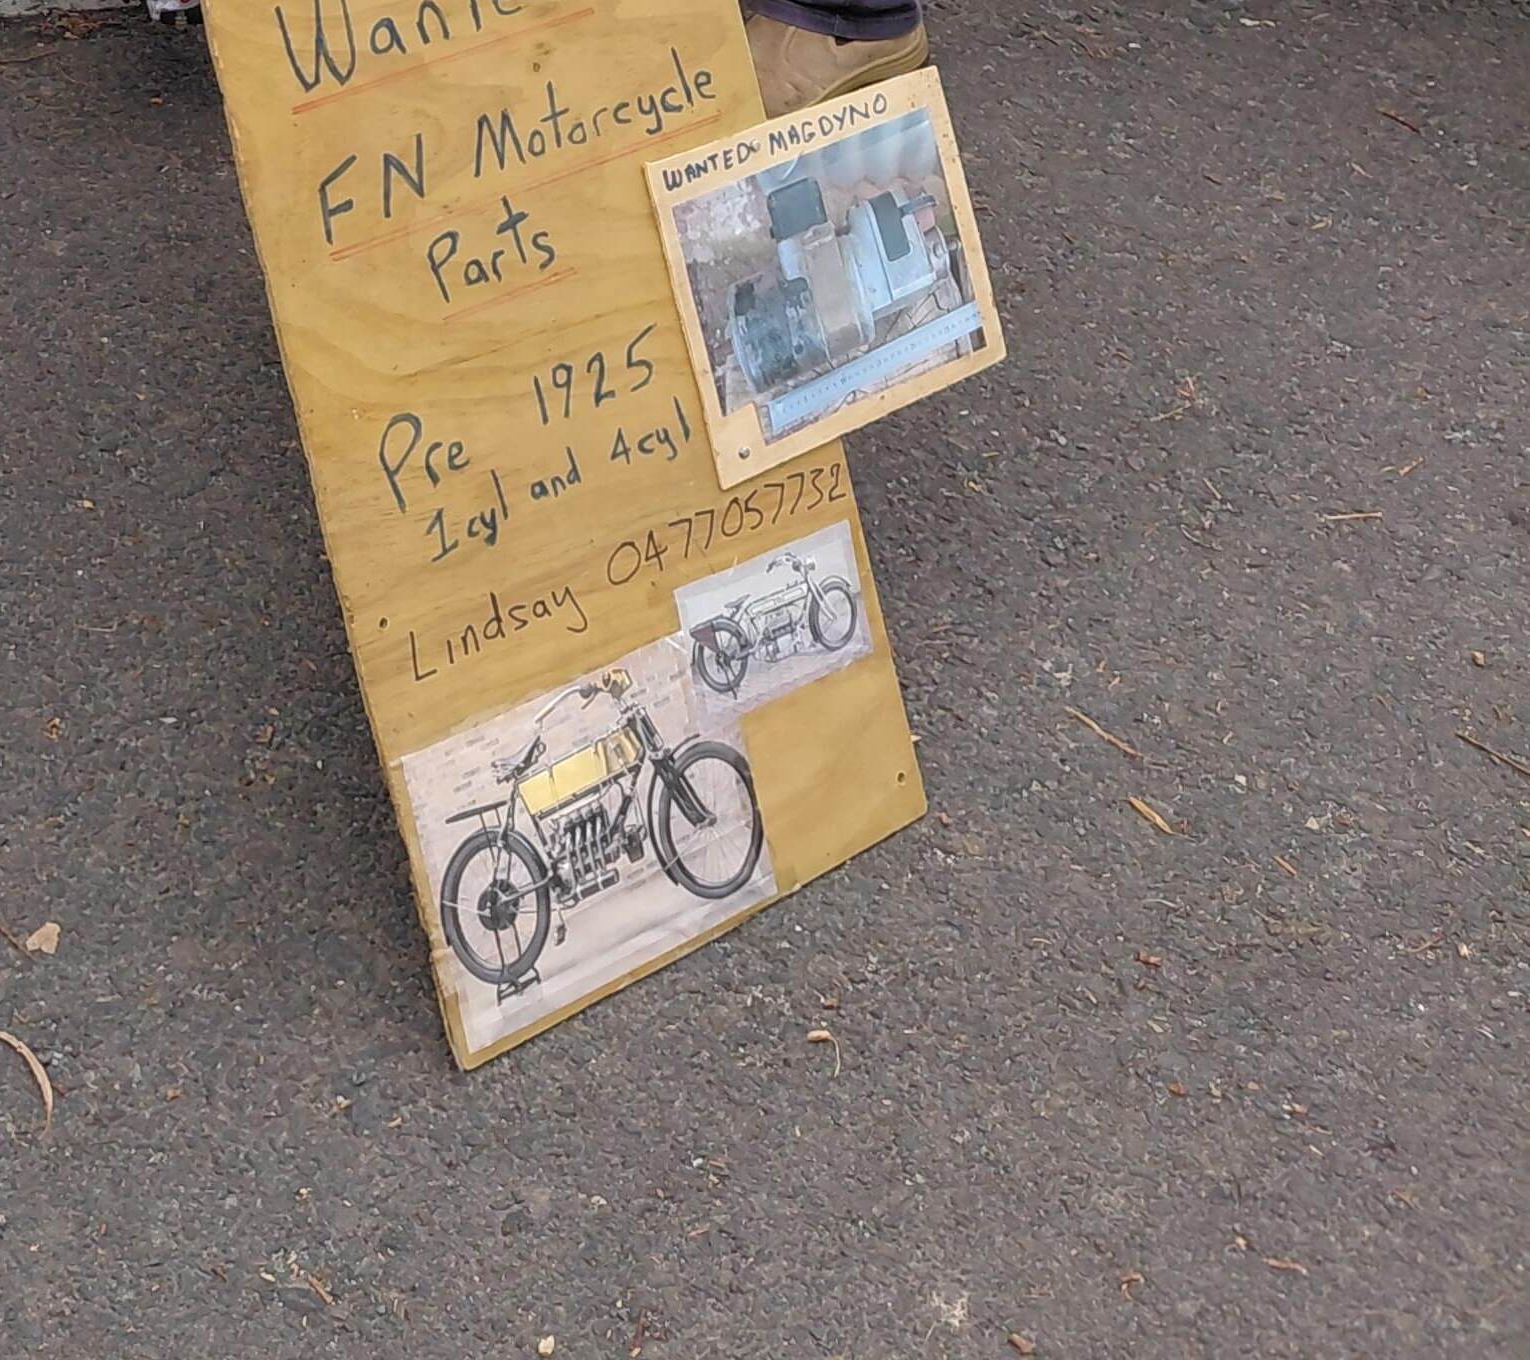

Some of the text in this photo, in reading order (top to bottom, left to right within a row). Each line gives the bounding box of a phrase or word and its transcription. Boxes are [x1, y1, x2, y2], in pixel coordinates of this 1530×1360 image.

[317, 46, 717, 246] FN Motorcycle
[661, 92, 888, 192] WANTED MAGDYNO
[426, 195, 557, 304] Parts
[378, 412, 470, 514] Pre
[533, 322, 657, 426] 1925
[530, 446, 582, 500] and
[408, 584, 588, 682] Lindsay
